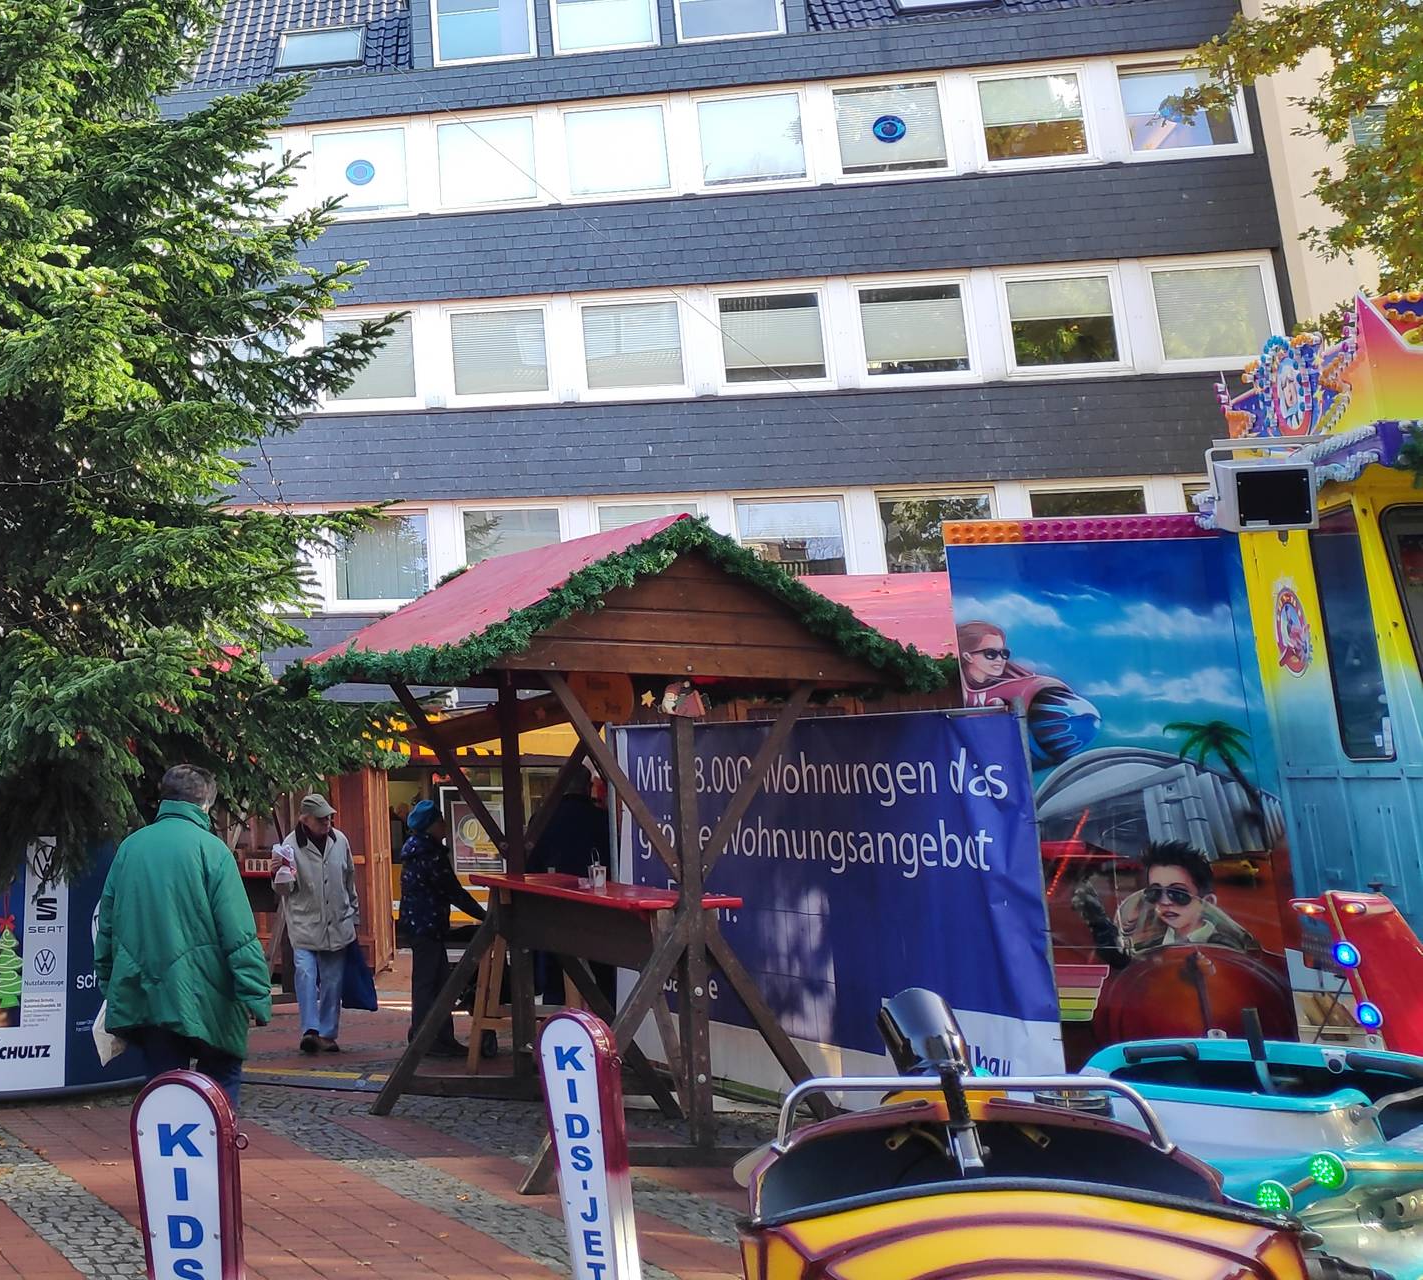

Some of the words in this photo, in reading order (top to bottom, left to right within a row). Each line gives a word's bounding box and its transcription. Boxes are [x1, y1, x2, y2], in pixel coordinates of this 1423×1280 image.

[637, 756, 673, 792] Mit
[694, 756, 752, 793] 8.000
[762, 751, 937, 806] Wohnungen
[948, 746, 1009, 799] das
[721, 816, 993, 878] Wohnungsangebot
[157, 1123, 204, 1280] KIDS
